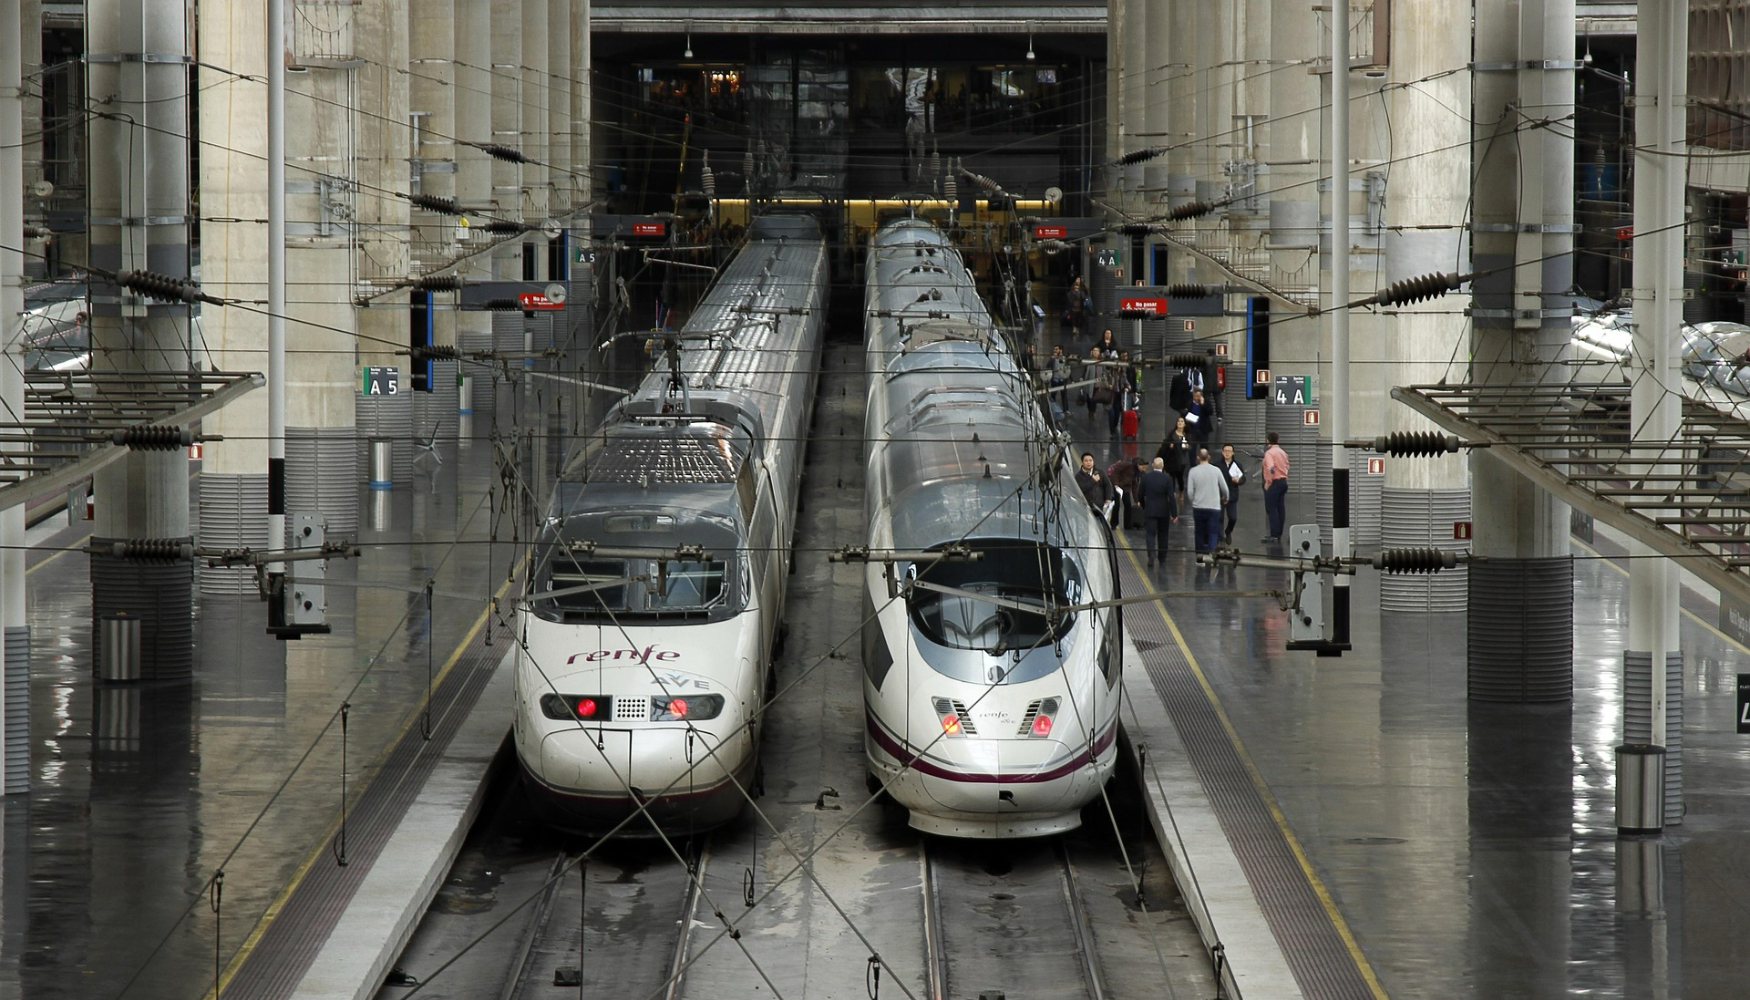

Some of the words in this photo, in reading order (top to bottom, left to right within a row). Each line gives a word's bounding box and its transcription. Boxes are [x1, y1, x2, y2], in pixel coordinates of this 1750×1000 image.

[580, 253, 586, 263] A
[589, 253, 596, 263] 5
[1098, 256, 1106, 266] 4
[1108, 256, 1116, 266] A
[1723, 257, 1729, 267] 2
[370, 379, 381, 395] A
[388, 379, 397, 395] 5
[1276, 388, 1287, 404] 4
[1293, 388, 1304, 404] A
[567, 644, 681, 665] renfe
[650, 672, 710, 690] AVE
